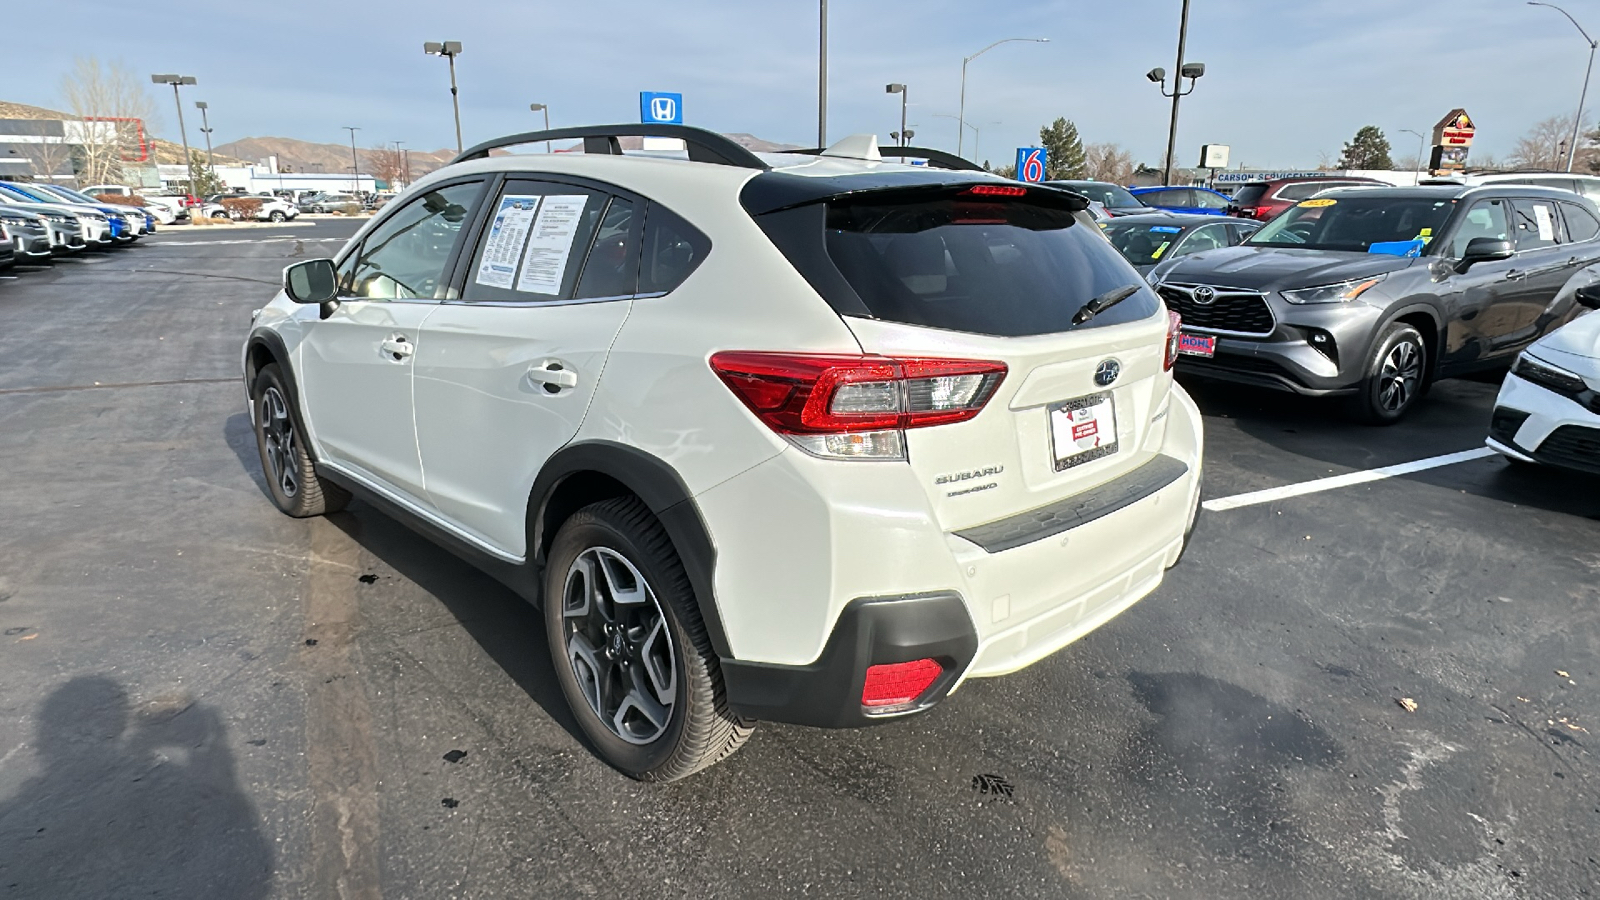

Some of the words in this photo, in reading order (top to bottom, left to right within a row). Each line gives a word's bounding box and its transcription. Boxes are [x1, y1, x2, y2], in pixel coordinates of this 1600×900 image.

[1023, 149, 1043, 182] 6
[1218, 173, 1254, 182] CARSON
[1182, 337, 1210, 348] HOHL
[935, 465, 1004, 485] SUBARU
